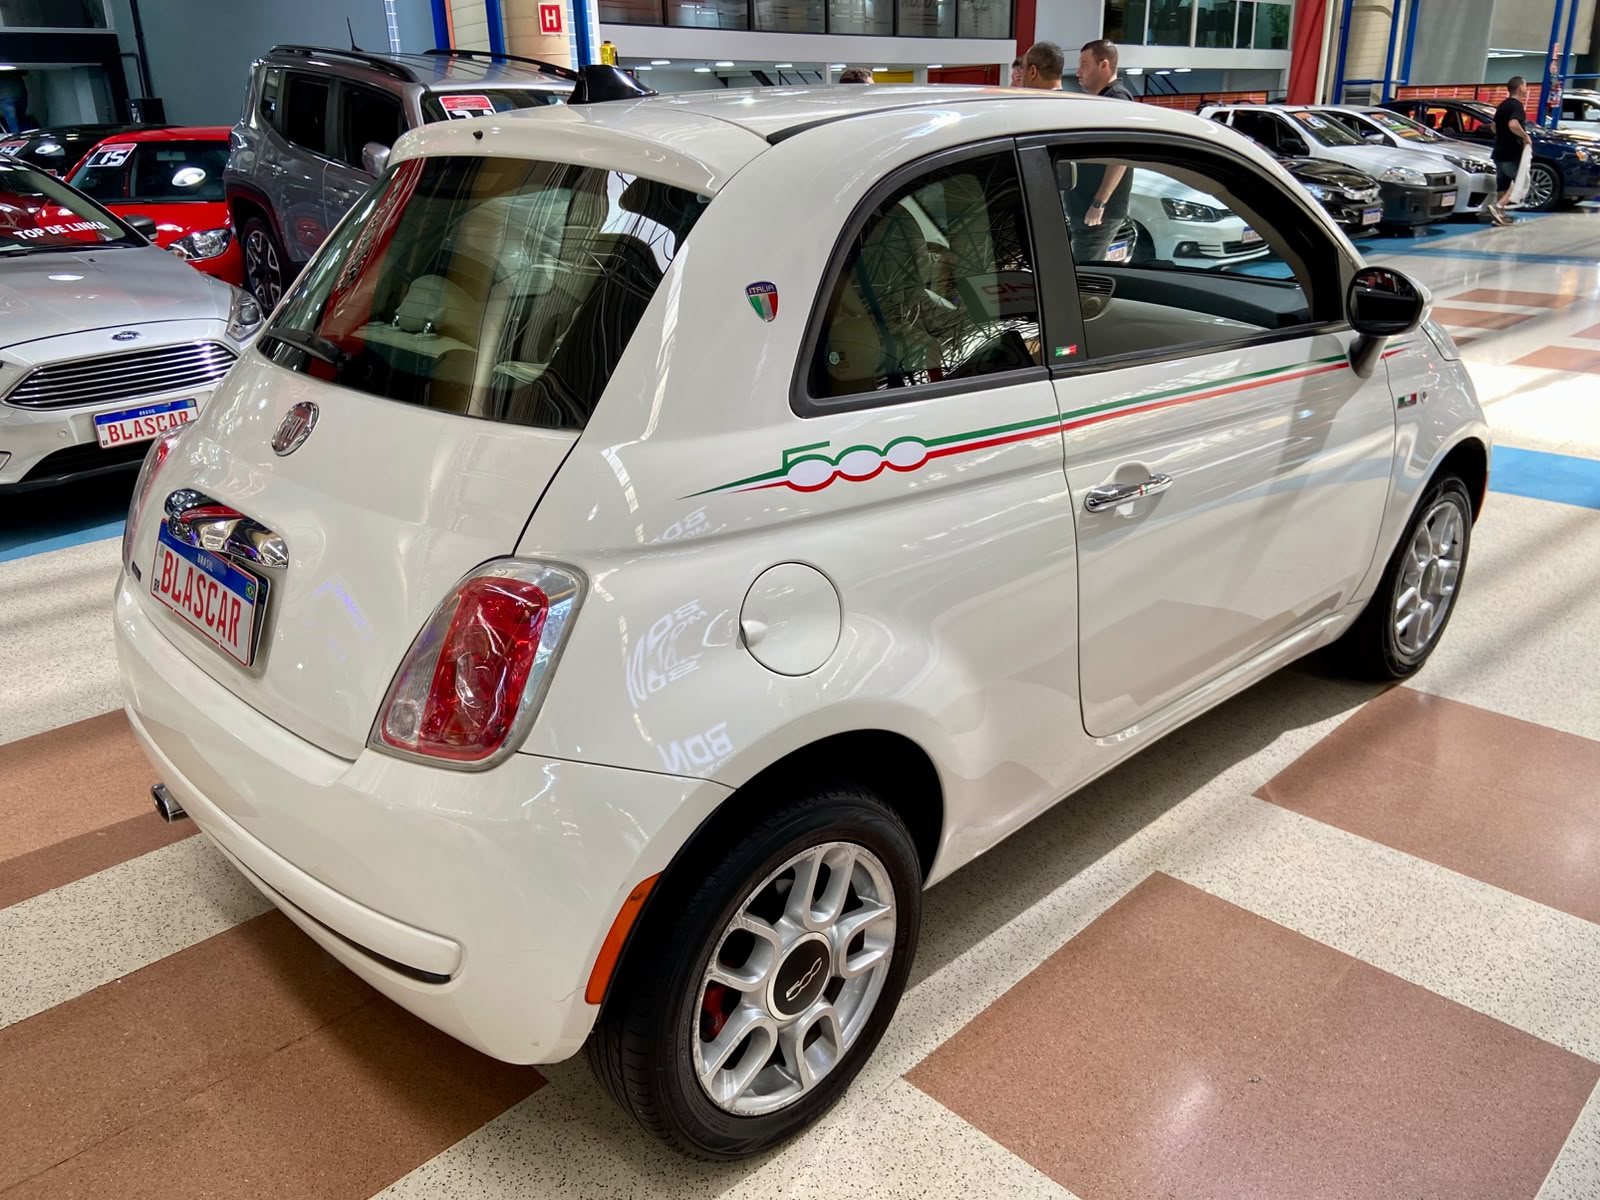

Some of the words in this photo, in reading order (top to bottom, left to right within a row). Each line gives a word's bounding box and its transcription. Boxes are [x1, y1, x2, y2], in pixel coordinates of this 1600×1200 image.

[545, 9, 557, 28] H
[100, 151, 126, 165] 15
[13, 227, 45, 239] TOP
[45, 224, 66, 235] DE
[65, 221, 110, 232] LINHA
[748, 285, 775, 294] ITALIA
[107, 410, 189, 443] BLASCAR
[782, 435, 930, 493] 500
[197, 553, 214, 573] BRASIL
[160, 550, 242, 648] BLASCAR
